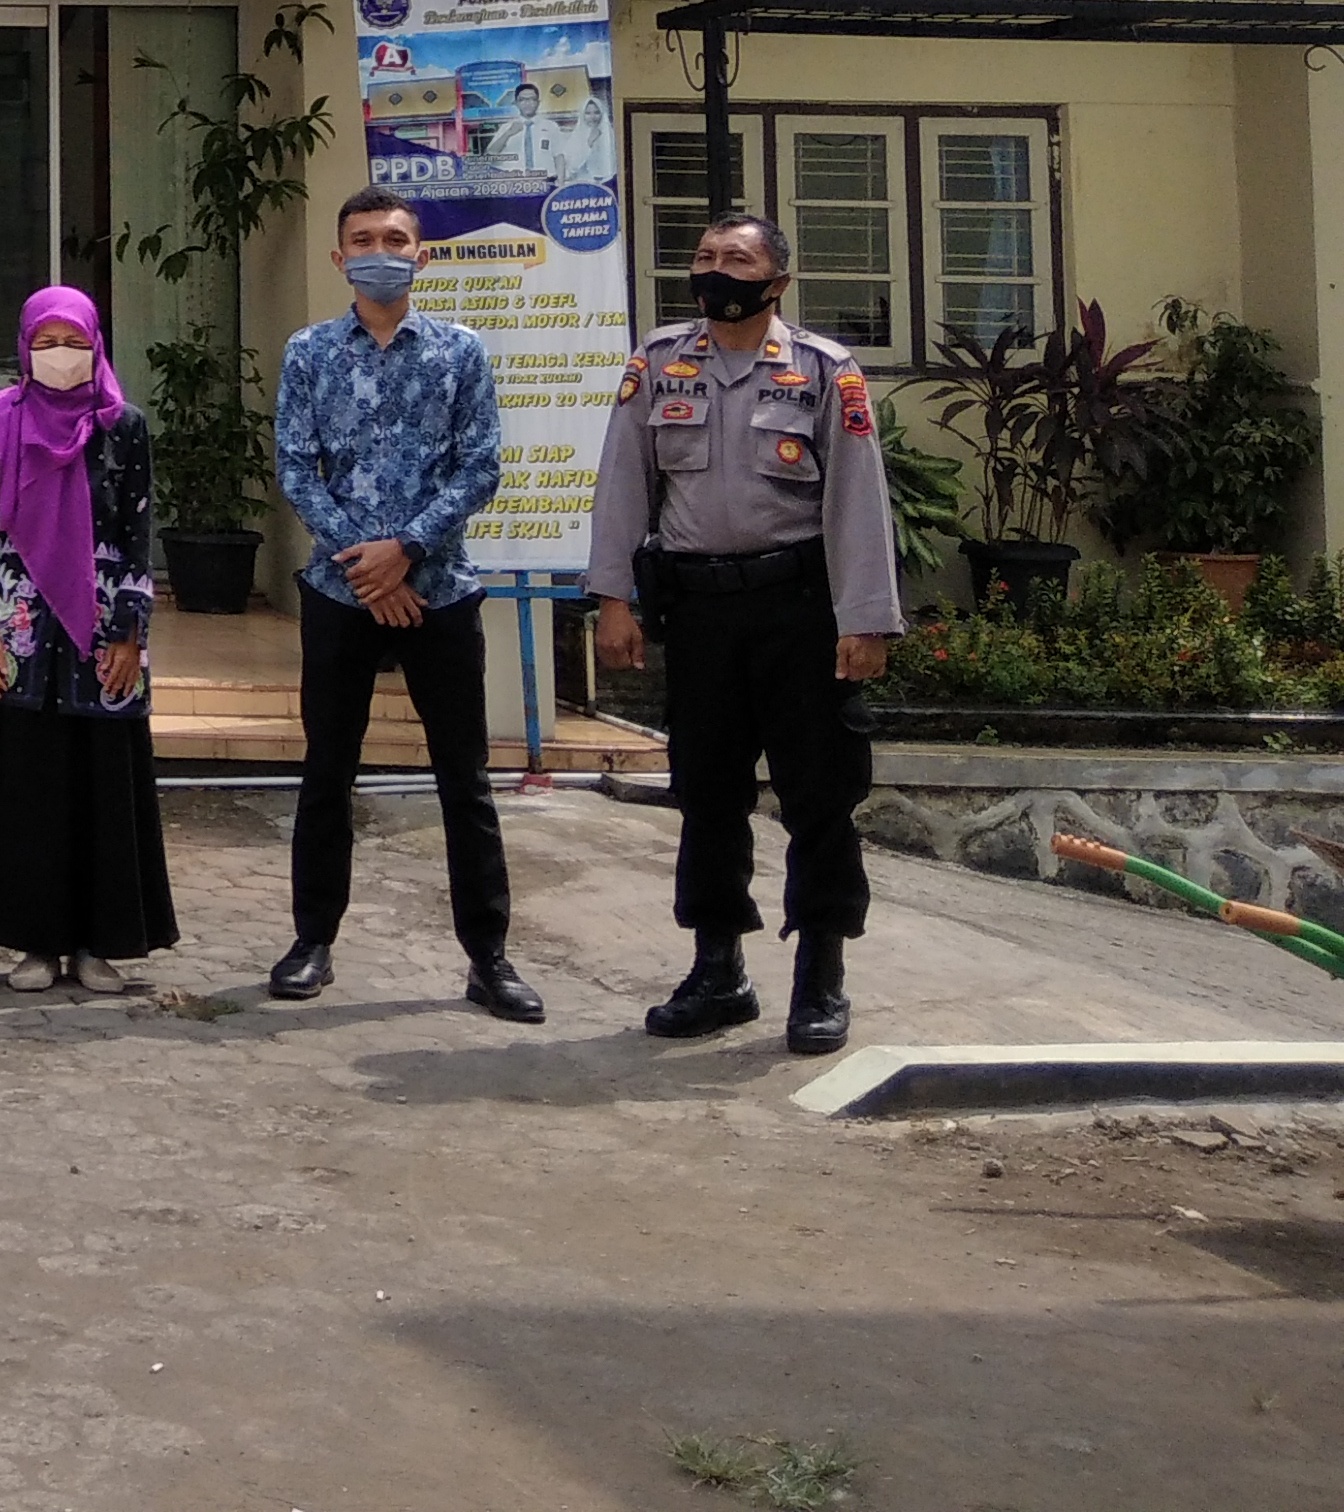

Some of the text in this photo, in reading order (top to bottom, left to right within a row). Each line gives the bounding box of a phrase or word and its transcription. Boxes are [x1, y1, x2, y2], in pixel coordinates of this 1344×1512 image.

[382, 48, 403, 65] A
[370, 155, 456, 185] PPDB
[420, 185, 469, 200] Ajaran
[473, 182, 549, 196] 2020/2021
[551, 196, 613, 212] DISIAPKAN
[560, 210, 608, 224] ASRAMA
[562, 224, 610, 238] TAHFIDZ
[456, 243, 537, 260] UNGGULAN
[410, 275, 522, 292] HFIDZ QUR'AN
[415, 293, 577, 312] HASA ASING & TOEFL
[522, 313, 580, 329] MOTOR
[596, 311, 626, 327] TSM
[506, 353, 568, 369] TENAGA
[572, 351, 624, 368] KERJA
[556, 392, 577, 407] 20
[758, 387, 816, 408] POLRI
[527, 444, 575, 464] SIAP
[536, 469, 598, 489] HAFID
[465, 520, 564, 541] LIFE SKILL
